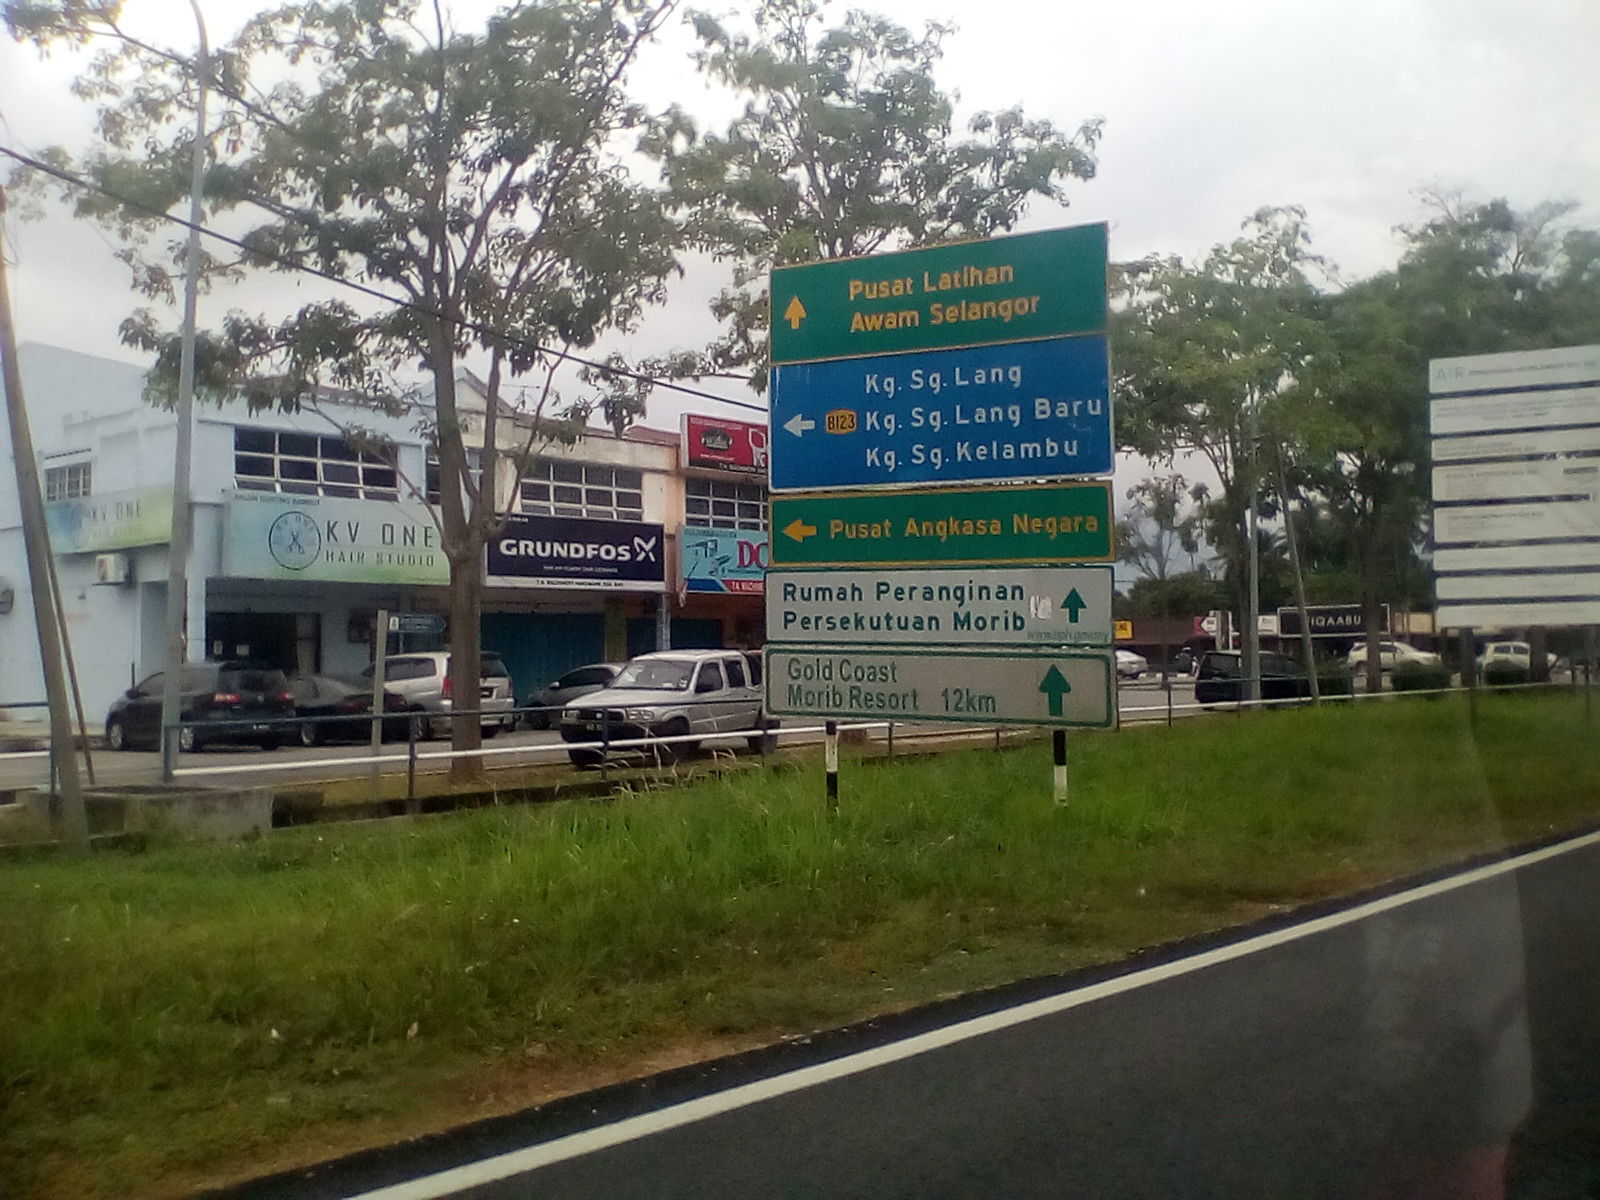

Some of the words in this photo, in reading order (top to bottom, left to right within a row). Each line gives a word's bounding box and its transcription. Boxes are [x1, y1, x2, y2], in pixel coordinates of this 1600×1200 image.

[848, 274, 914, 301] Pusat
[923, 264, 1015, 293] Latihan
[850, 309, 920, 334] Awam
[929, 295, 1041, 325] Selangor
[865, 374, 903, 399] Kg.
[910, 367, 948, 393] Sg.
[955, 365, 1023, 389] Lang
[827, 410, 857, 430] B123
[865, 410, 903, 436] Kg.
[910, 406, 949, 433] Sg.
[955, 403, 1022, 427] Lang
[1034, 397, 1103, 420] Baru
[866, 447, 903, 472] Kg.
[911, 443, 950, 469] Sg.
[956, 437, 1080, 462] Kelambu
[326, 520, 360, 544] KV
[381, 523, 434, 549] ONE
[829, 518, 892, 540] Pusat
[904, 516, 1001, 543] Angkasa
[1012, 512, 1099, 541] Negara
[326, 549, 364, 563] HAIR
[376, 551, 434, 567] STUDIO
[499, 538, 632, 562] GRUNDFOS
[783, 583, 863, 602] Rumah
[875, 580, 1025, 607] Peranginan
[782, 610, 940, 632] Persekutuan
[952, 610, 1026, 631] Morib
[788, 657, 833, 682] Gold
[839, 660, 898, 683] Coast
[787, 684, 842, 708] Morib
[850, 687, 919, 711] Resort
[941, 687, 998, 713] 12km
